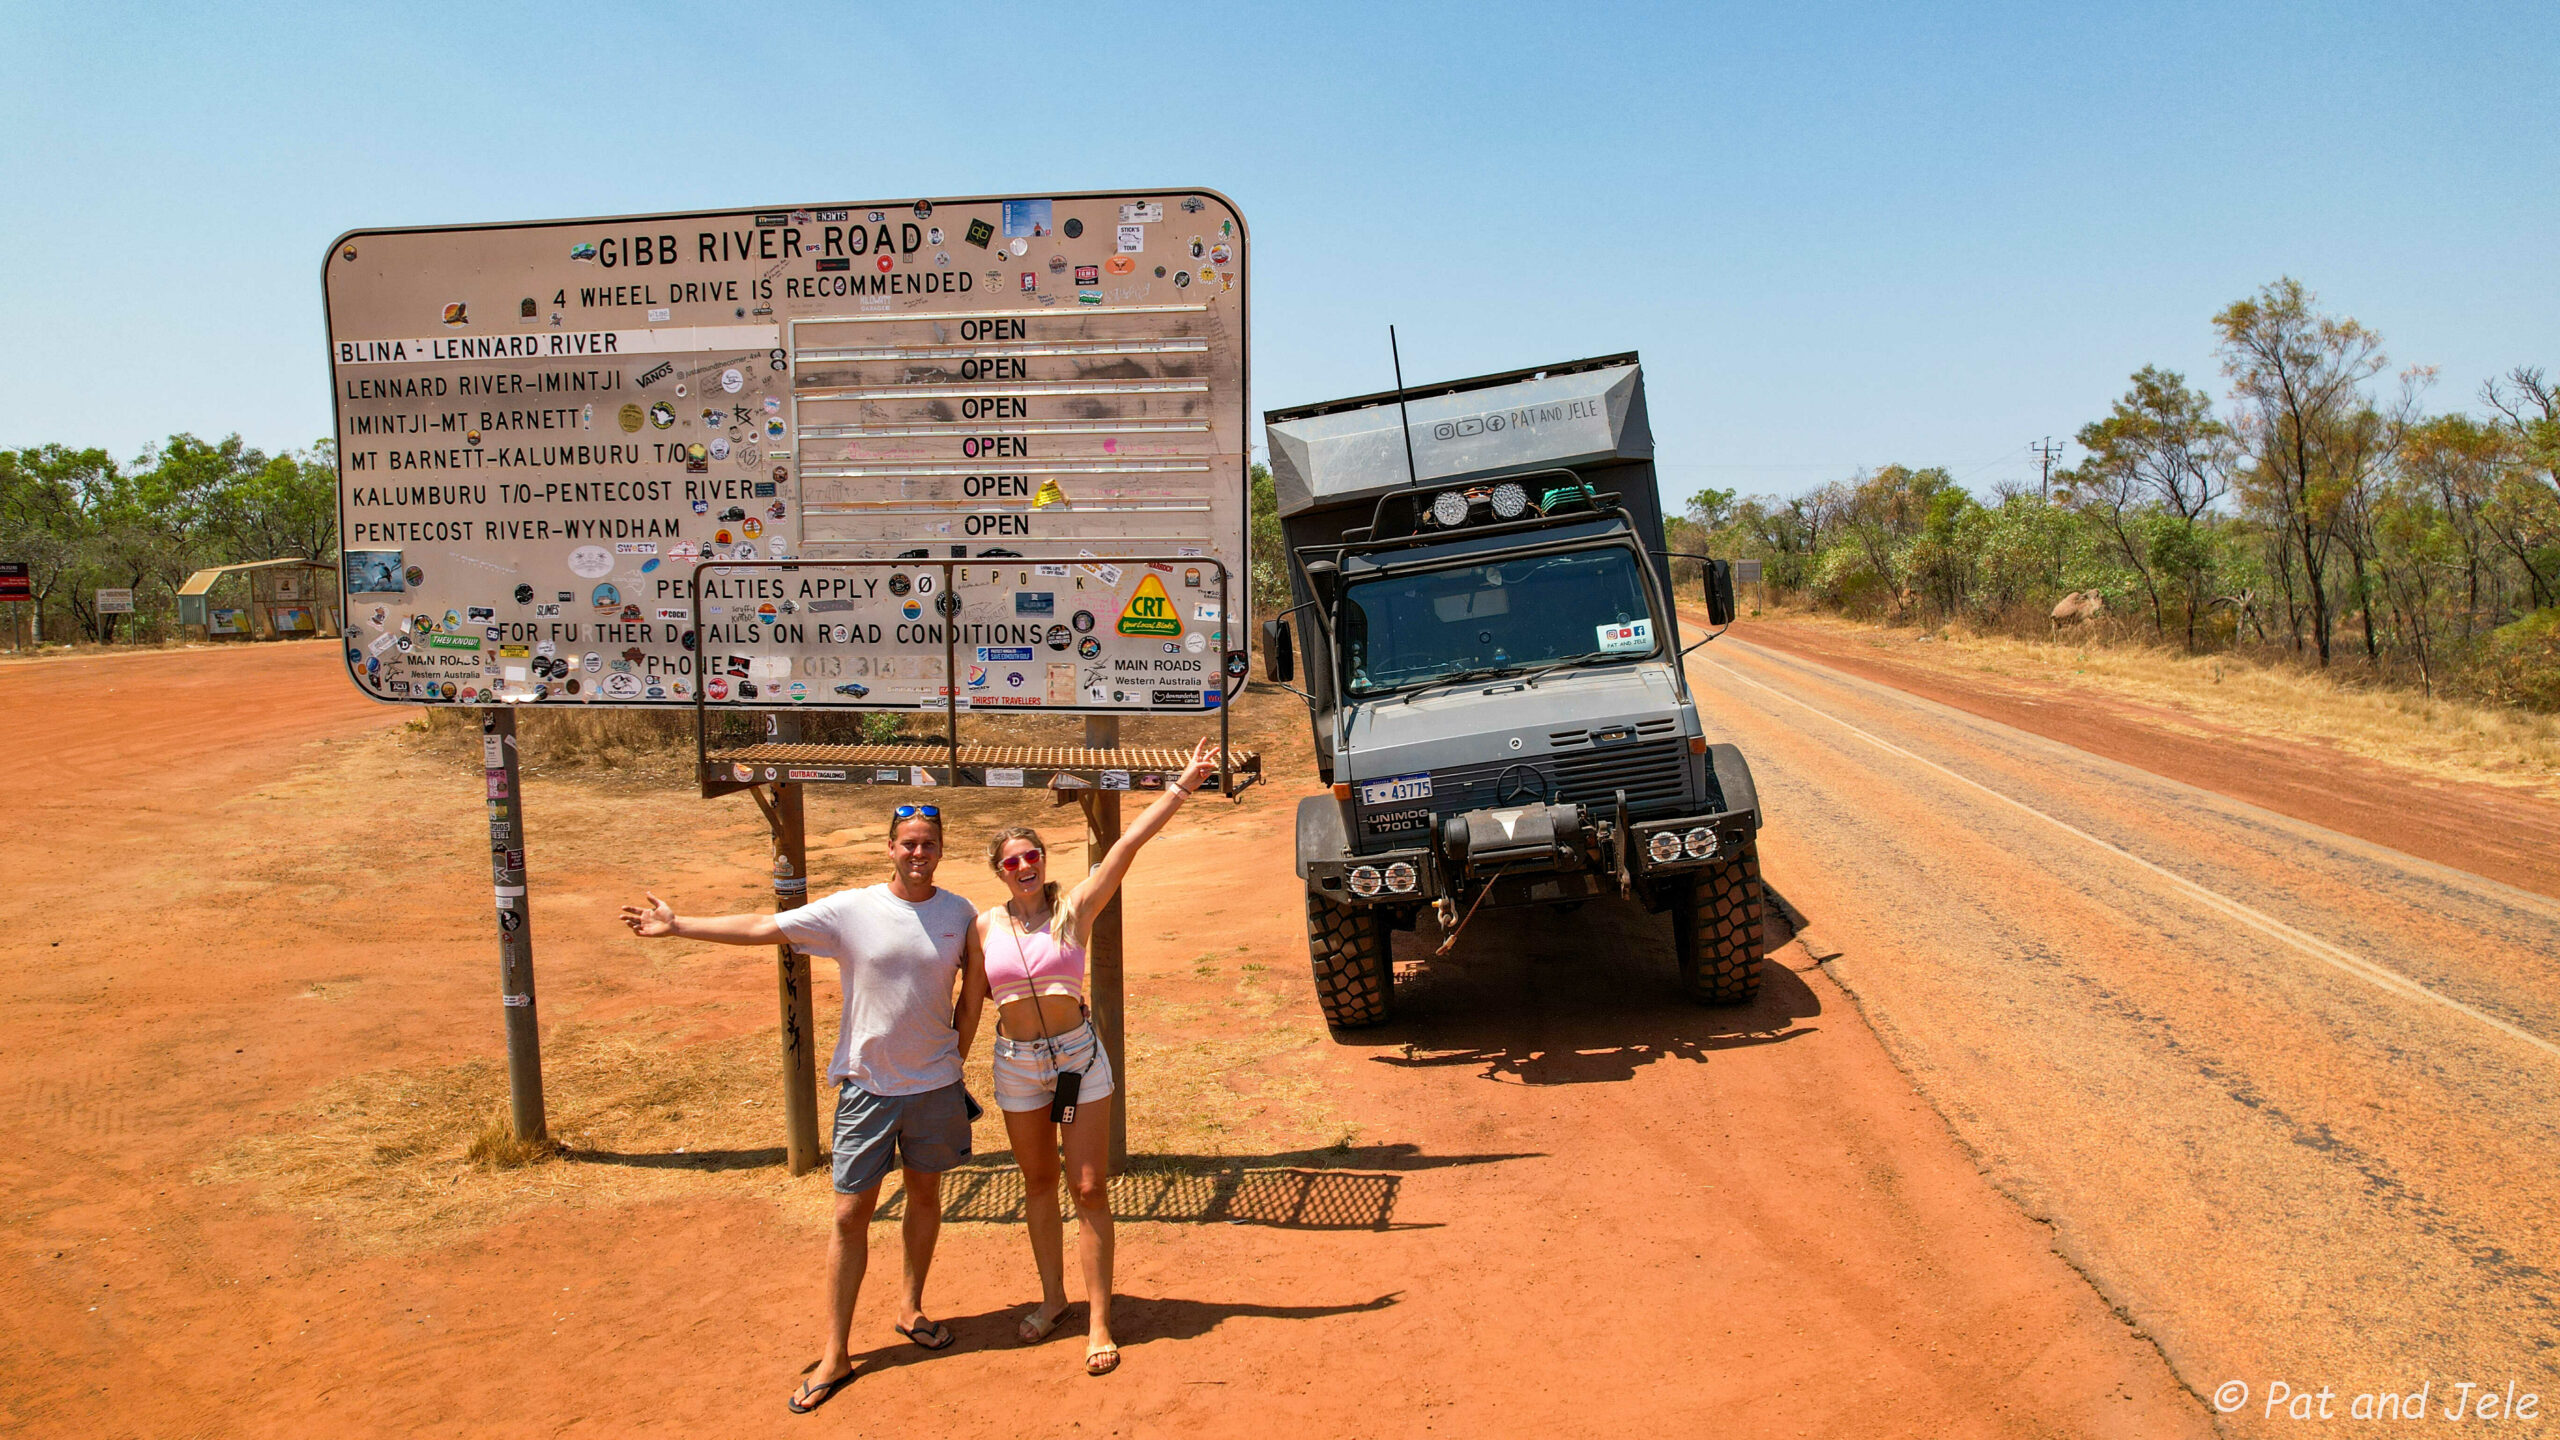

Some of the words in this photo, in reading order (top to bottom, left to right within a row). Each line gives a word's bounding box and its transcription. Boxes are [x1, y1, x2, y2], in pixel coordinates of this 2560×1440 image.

[599, 235, 678, 268] GIBB
[699, 228, 802, 263] RIVER
[825, 223, 922, 256] ROAD
[553, 289, 566, 309] 4
[581, 284, 657, 307] WHEEL
[670, 280, 739, 304] DRIVE
[752, 278, 774, 300] IS
[787, 271, 973, 299] RECOMMENDED
[960, 318, 1026, 340] OPEN
[341, 341, 406, 363] BLINA
[433, 335, 539, 360] LENNARD
[550, 333, 618, 356] RIVER
[635, 361, 674, 389] VANOS
[960, 357, 1027, 379] OPEN
[347, 376, 447, 400] LENNARD
[459, 369, 622, 395] RIVER-IMINTJI
[961, 397, 1028, 419] OPEN
[1511, 409, 1535, 430] PAT
[1540, 406, 1564, 422] AND
[1567, 399, 1598, 422] JELE
[349, 411, 469, 436] IMINTJI-MT
[480, 408, 580, 432] BARNETT
[352, 450, 379, 472] MT
[390, 443, 640, 470] BARNETT-KALUMBURU
[654, 442, 687, 465] T/O
[962, 436, 1028, 458] OPEN
[353, 485, 487, 508] KALUMBURU
[502, 481, 673, 504] T/O-PENTECOST
[685, 479, 753, 500] RIVER
[964, 475, 1029, 497] OPEN
[354, 522, 473, 543] PENTECOST
[486, 518, 681, 541] RIVER-WYNDHAM
[965, 515, 1030, 536] OPEN
[800, 577, 879, 599] APPLY
[668, 610, 687, 619] COCK!
[1132, 597, 1165, 618] CRT
[432, 636, 452, 645] THEY
[452, 637, 479, 646] KNOW!
[499, 623, 538, 642] FOR
[774, 623, 804, 643] ON
[1607, 641, 1619, 649] PAT
[1634, 637, 1646, 645] JELE
[440, 655, 480, 666] ROAS
[1115, 659, 1148, 671] MAIN
[1154, 660, 1202, 671] ROADS
[444, 669, 480, 679] Australia
[1115, 676, 1155, 685] Western
[1159, 677, 1202, 686] Australia
[972, 696, 999, 704] THIRSTY
[1002, 696, 1041, 705] TRAVELLERS
[790, 770, 818, 778] OUTBACK
[817, 771, 846, 780] TAGALONGS
[1366, 789, 1376, 803] E
[1392, 782, 1431, 799] 43775
[1369, 808, 1429, 823] UNIMOG
[1376, 821, 1412, 833] 1700
